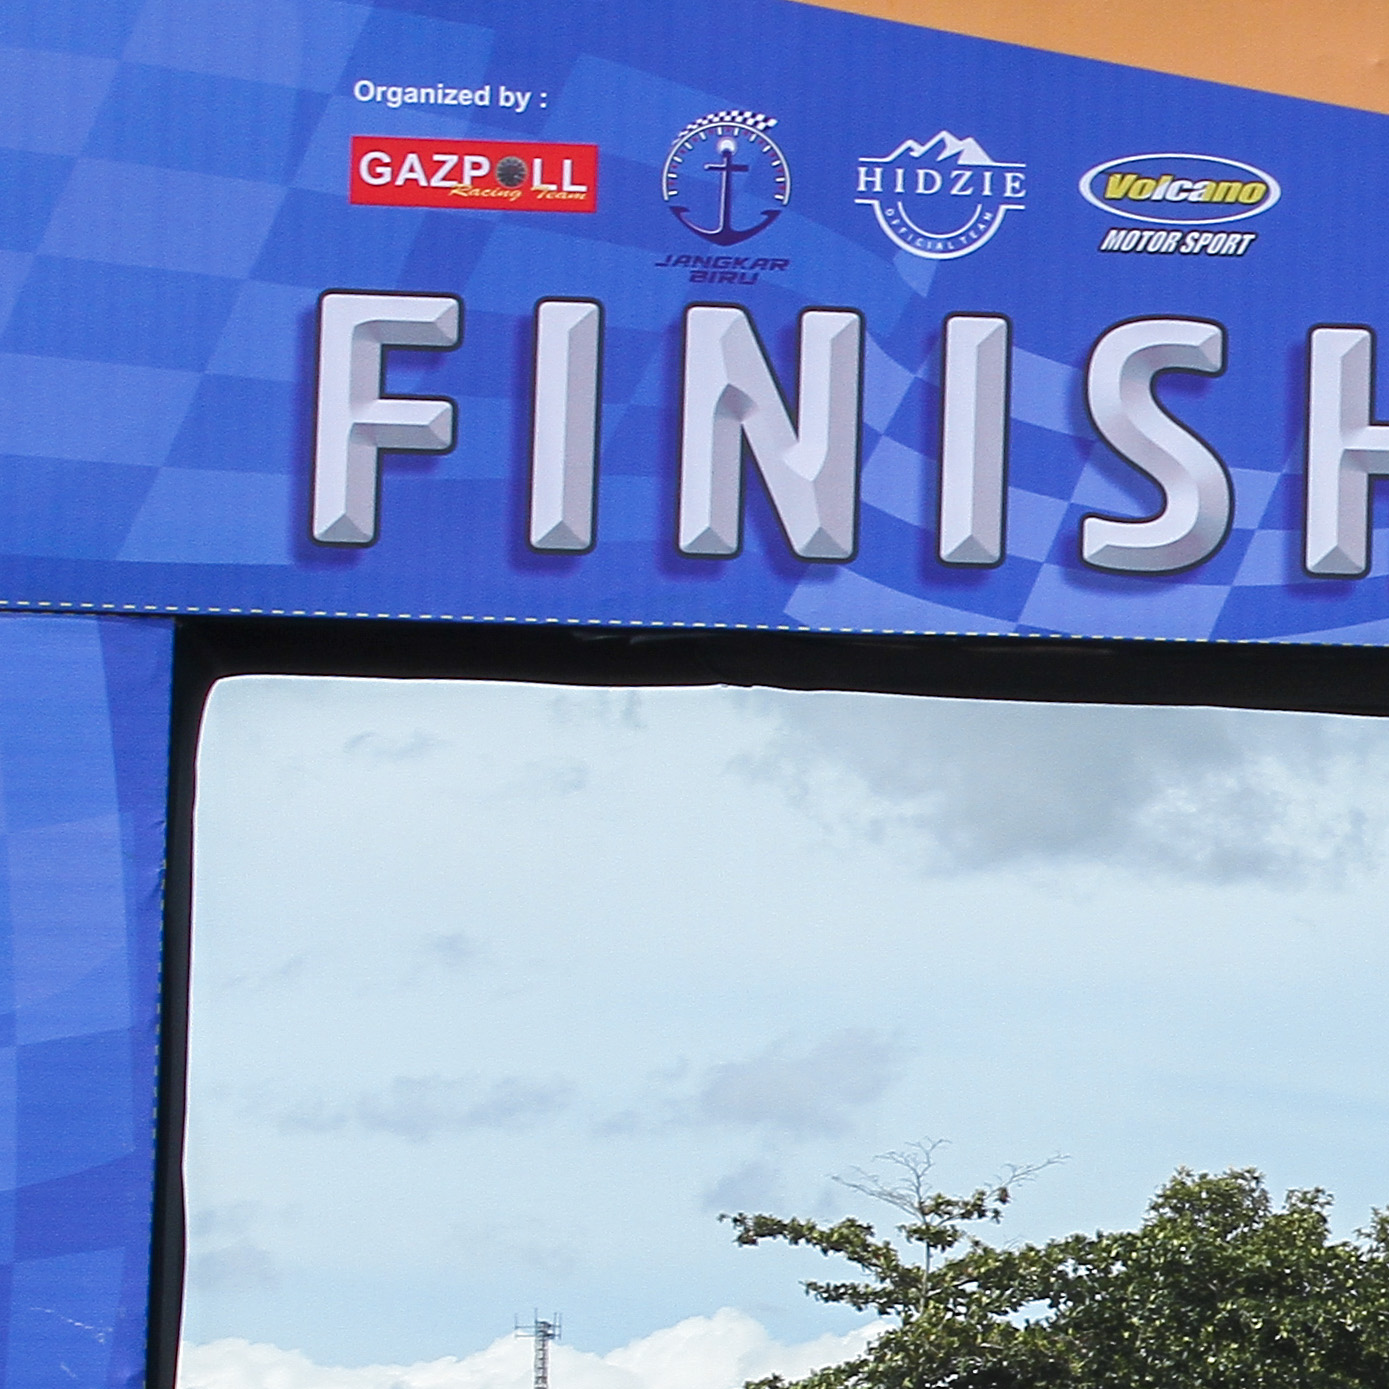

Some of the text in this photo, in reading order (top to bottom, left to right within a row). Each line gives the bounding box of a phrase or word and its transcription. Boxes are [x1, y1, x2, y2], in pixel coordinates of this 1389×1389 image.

[354, 79, 491, 110] Organized
[499, 83, 531, 113] by
[448, 182, 589, 202] Racing Team
[856, 166, 1027, 199] HIDZIE
[1103, 172, 1269, 205] Volcano
[884, 207, 994, 251] OFFICIAL TEAM
[1099, 228, 1258, 257] MOTOR SPORT
[655, 254, 791, 273] JANGKAR
[688, 269, 760, 286] BIRU
